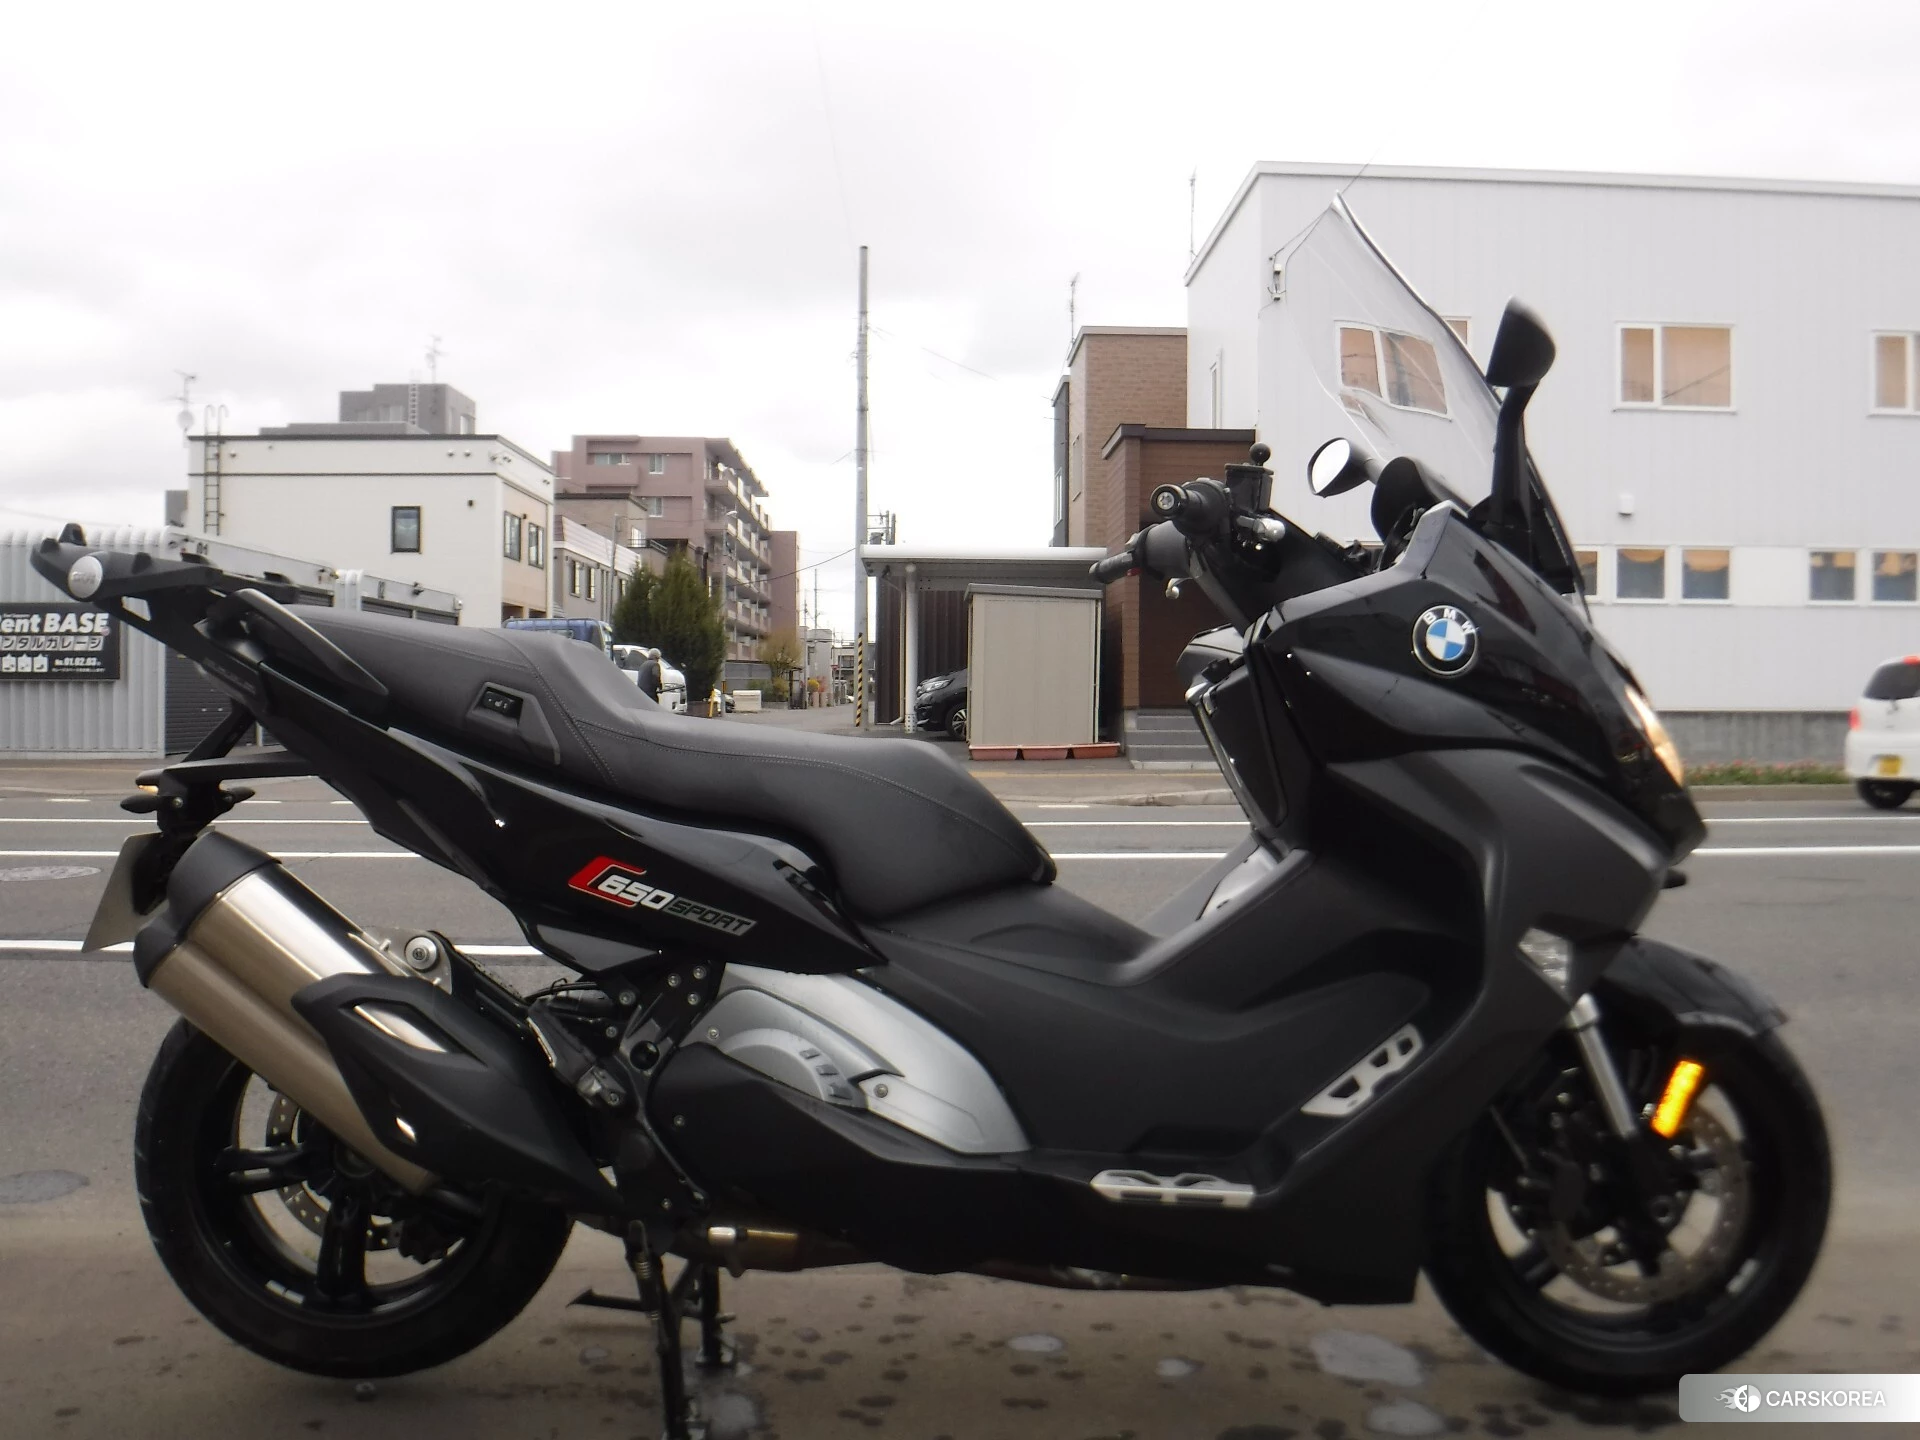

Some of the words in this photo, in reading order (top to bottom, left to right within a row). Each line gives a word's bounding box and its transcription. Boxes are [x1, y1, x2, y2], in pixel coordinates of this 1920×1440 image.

[0, 612, 41, 633] ent
[43, 612, 109, 633] BASE
[1422, 607, 1476, 636] BMW
[665, 898, 755, 935] SPORT
